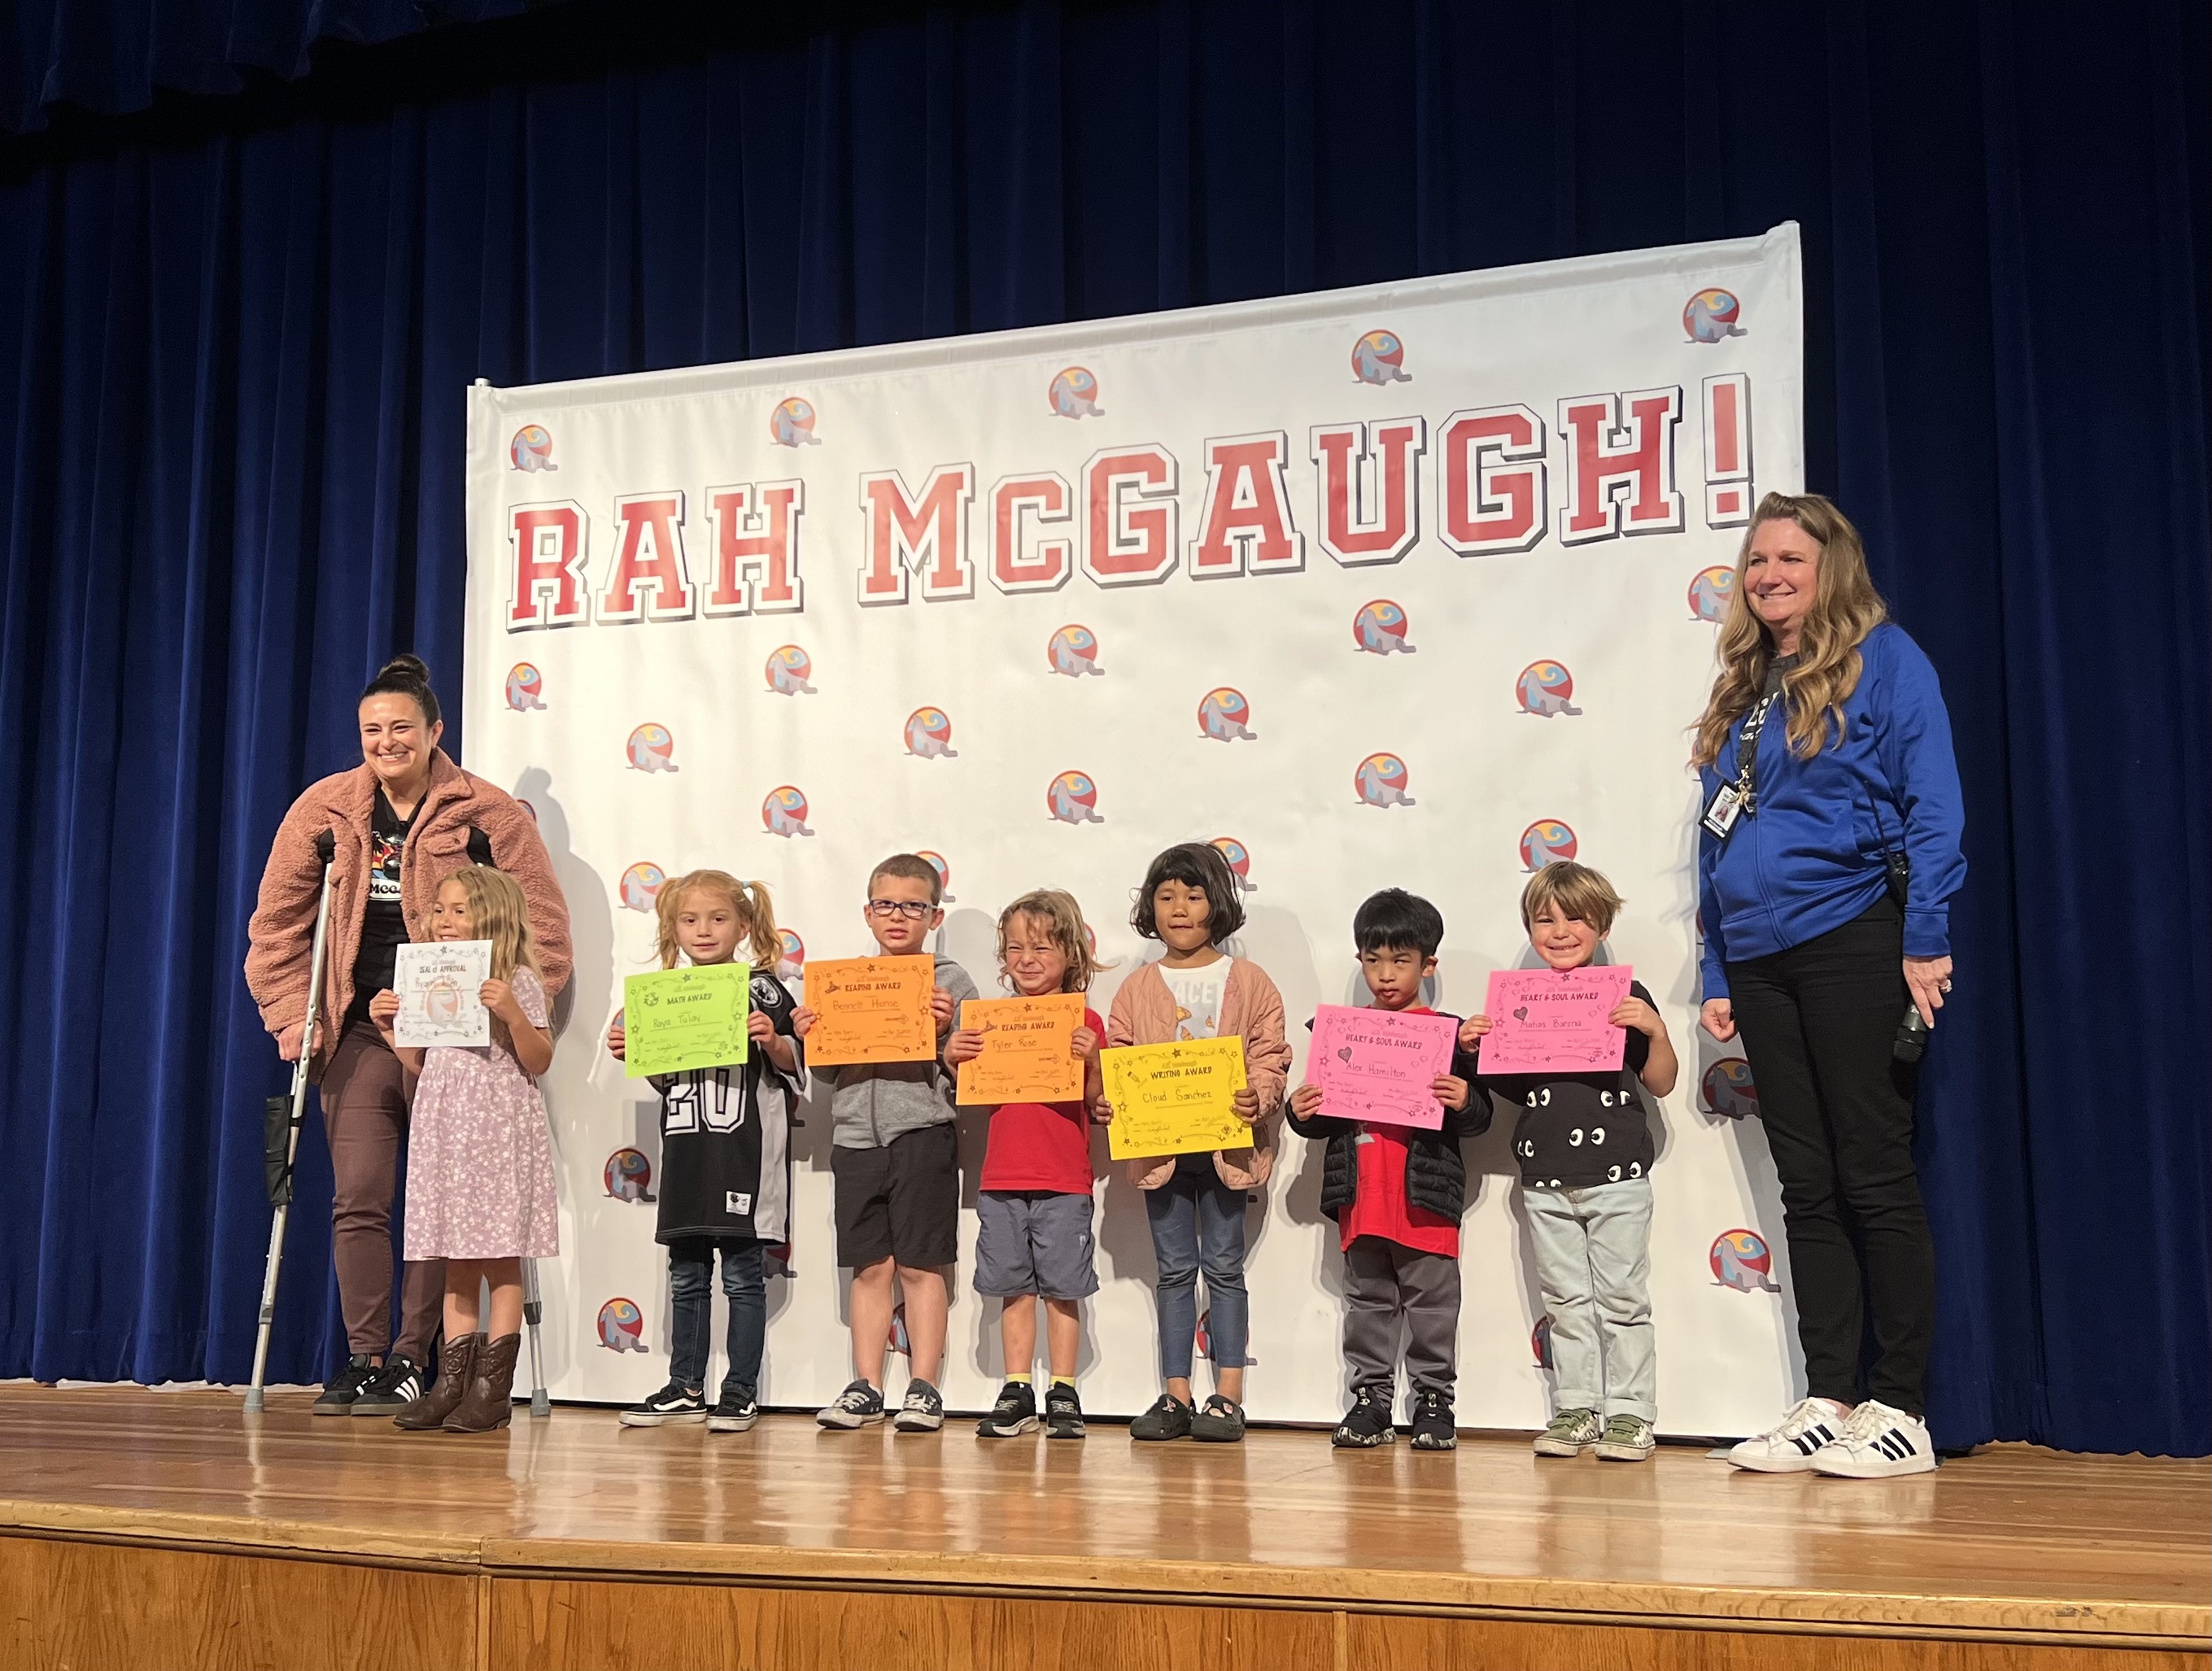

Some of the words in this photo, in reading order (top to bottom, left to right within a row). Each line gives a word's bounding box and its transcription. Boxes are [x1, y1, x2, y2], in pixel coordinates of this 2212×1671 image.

[506, 478, 805, 635] RAH
[875, 982, 901, 990] AWARD
[667, 996, 686, 1005] MATH
[687, 993, 712, 1002] AWARD
[1520, 993, 1542, 1001] HEART
[1571, 992, 1599, 1001] AWARD
[992, 1040, 1013, 1050] Tyler
[1346, 1034, 1368, 1043] HEART
[1376, 1036, 1393, 1046] SOUL
[1394, 1040, 1423, 1049] AWARD
[1150, 1069, 1181, 1080] WRITING
[1185, 1066, 1212, 1077] AWARD
[1346, 1062, 1363, 1072] Alex
[1368, 1063, 1406, 1078] Hamilton
[1142, 1091, 1167, 1103] Cloud
[1175, 1088, 1213, 1101] Sanchez
